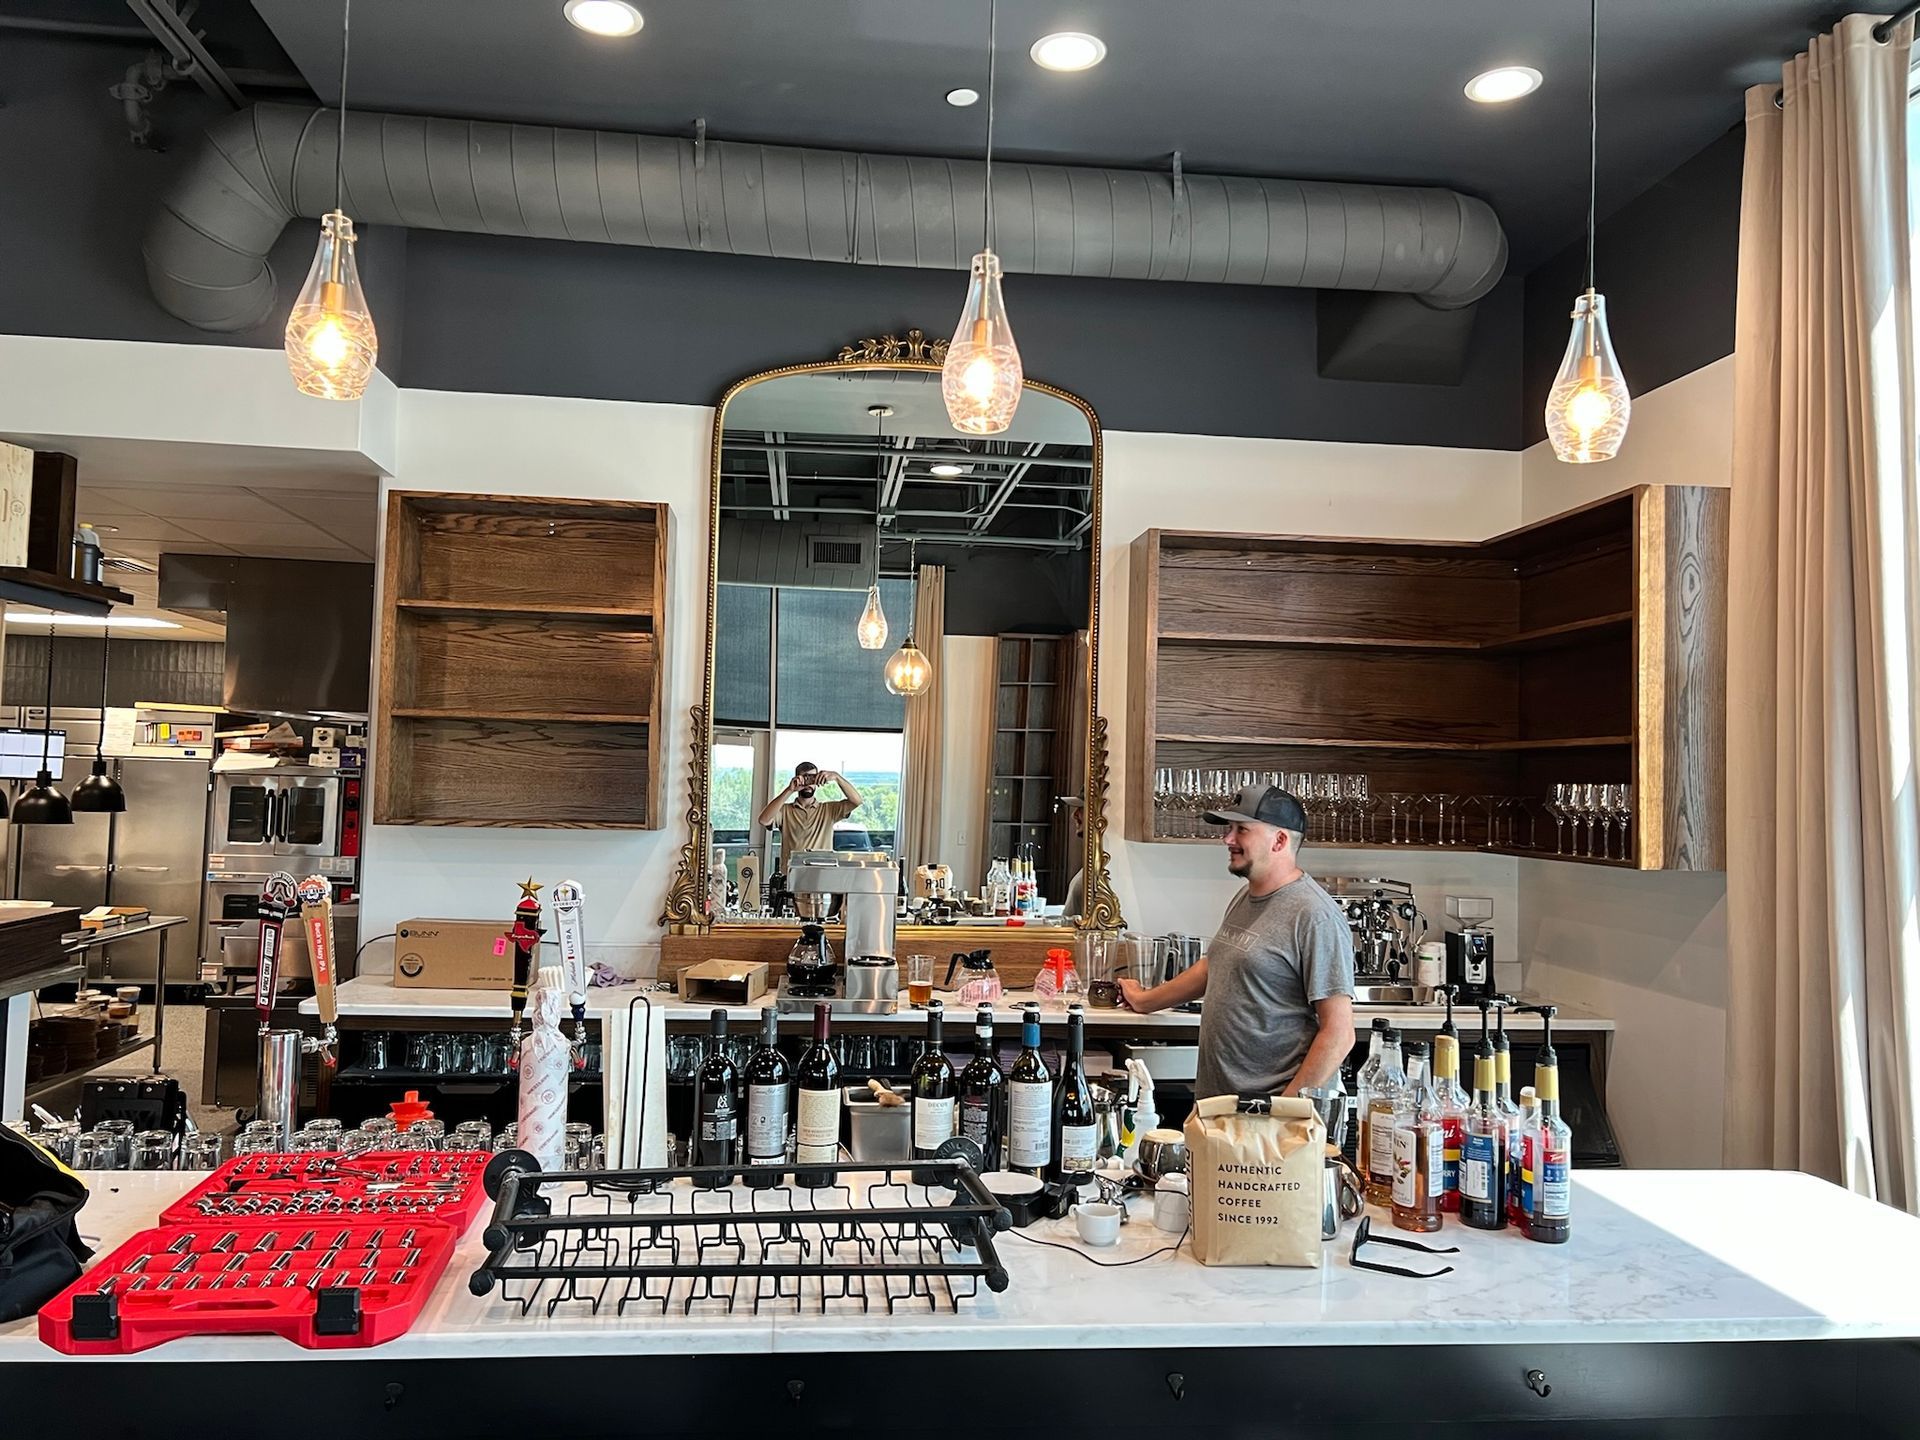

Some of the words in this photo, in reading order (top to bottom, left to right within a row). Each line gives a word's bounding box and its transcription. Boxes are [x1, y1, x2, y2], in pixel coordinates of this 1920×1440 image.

[566, 928, 574, 955] ULTRA
[316, 944, 325, 960] Hazy
[1217, 1163, 1282, 1175] AUTHENTIC
[1218, 1180, 1301, 1192] HANDCRAFTED
[1218, 1196, 1262, 1208] COFFEE
[1217, 1212, 1252, 1224] SINCE
[1255, 1216, 1279, 1225] 1992
